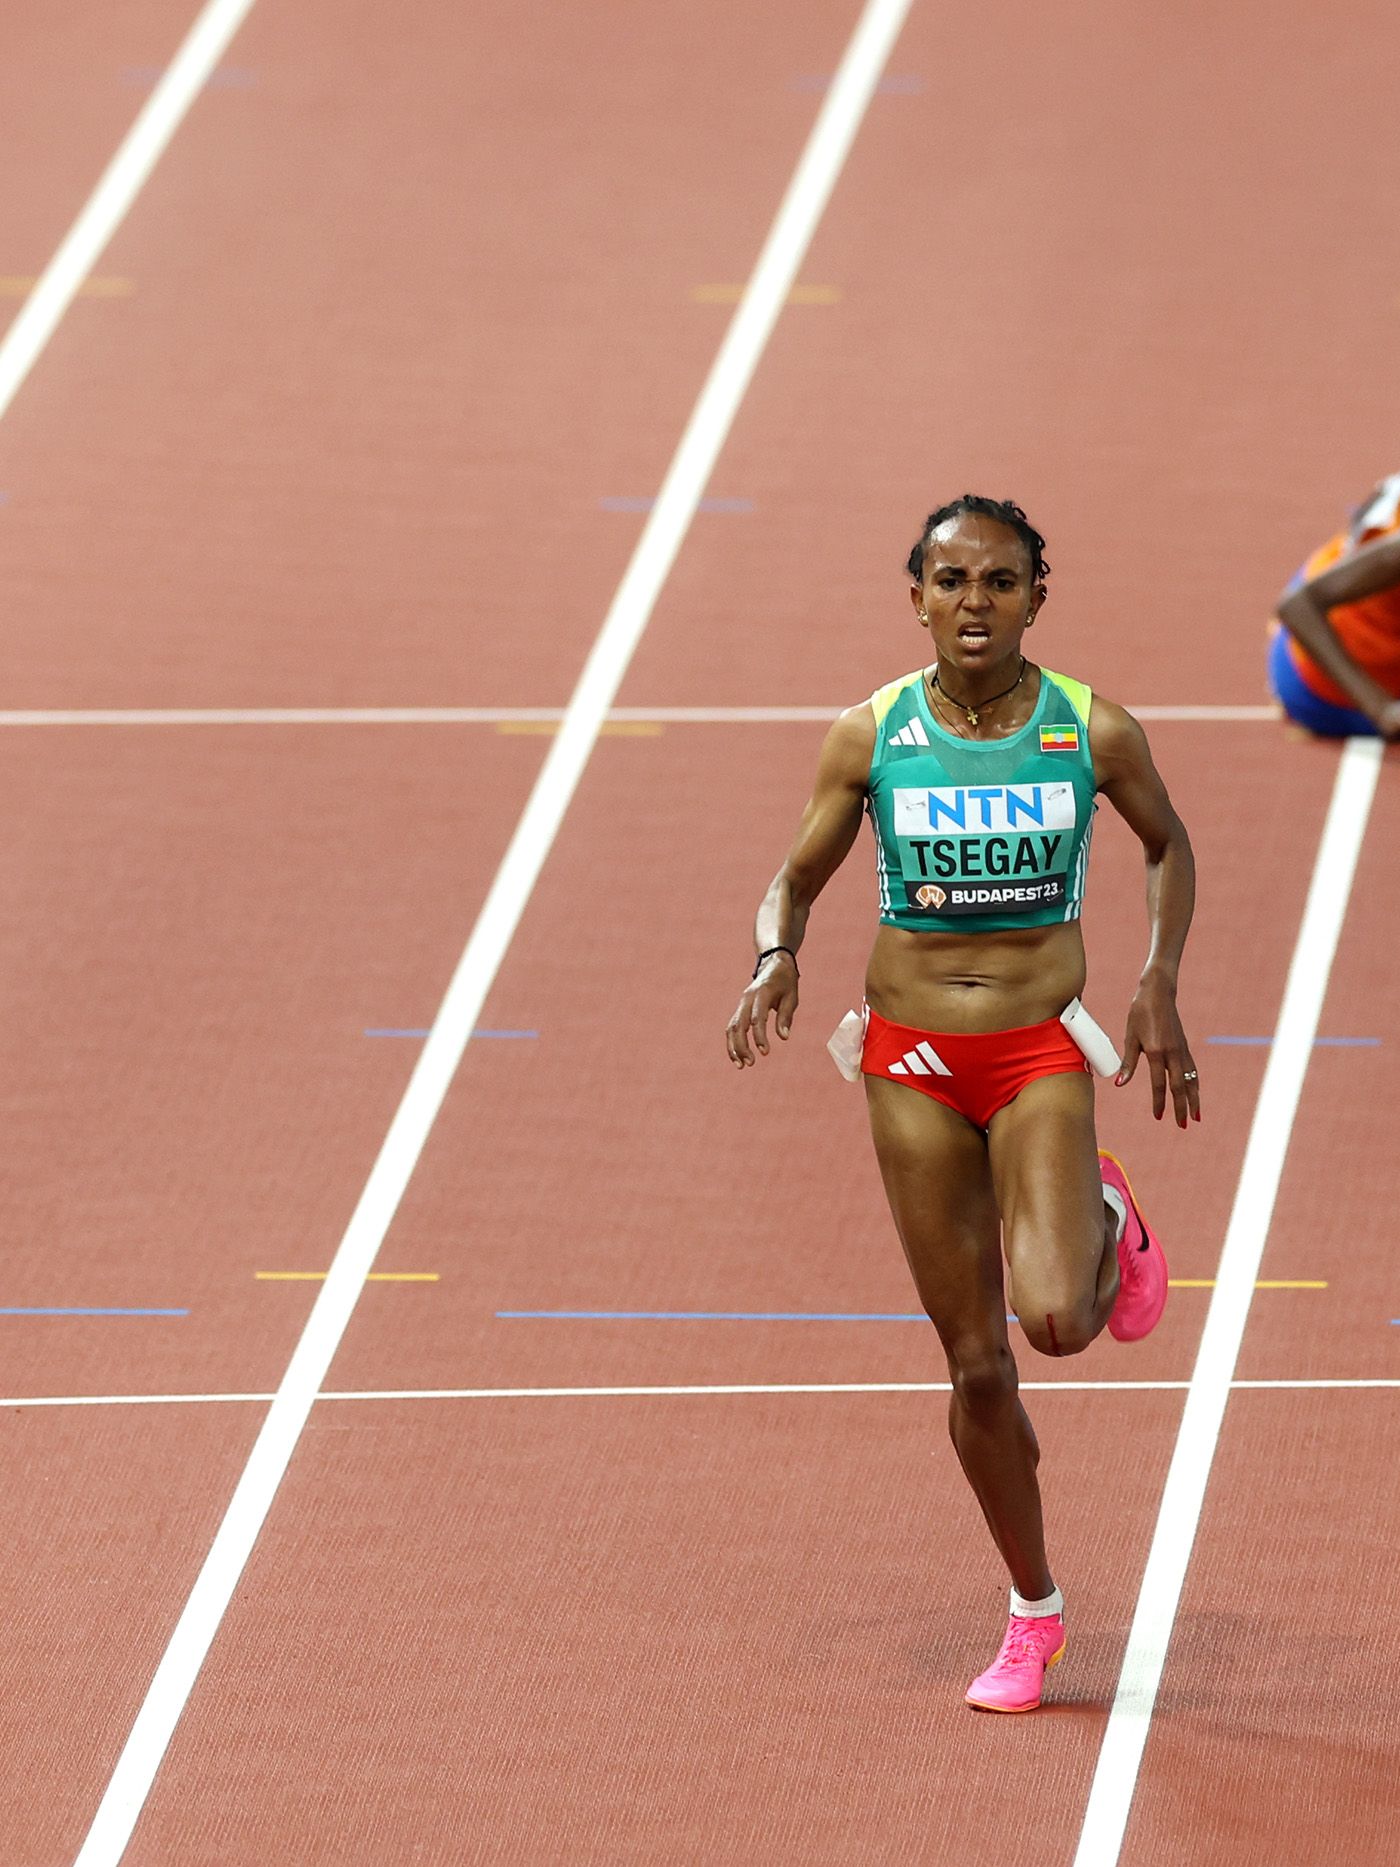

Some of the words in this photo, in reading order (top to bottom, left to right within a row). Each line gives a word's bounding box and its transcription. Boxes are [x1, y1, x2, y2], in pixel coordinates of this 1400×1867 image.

[928, 786, 1044, 831] NTN
[909, 834, 1063, 877] TSEGAY
[951, 886, 1043, 904] BUDAPEST
